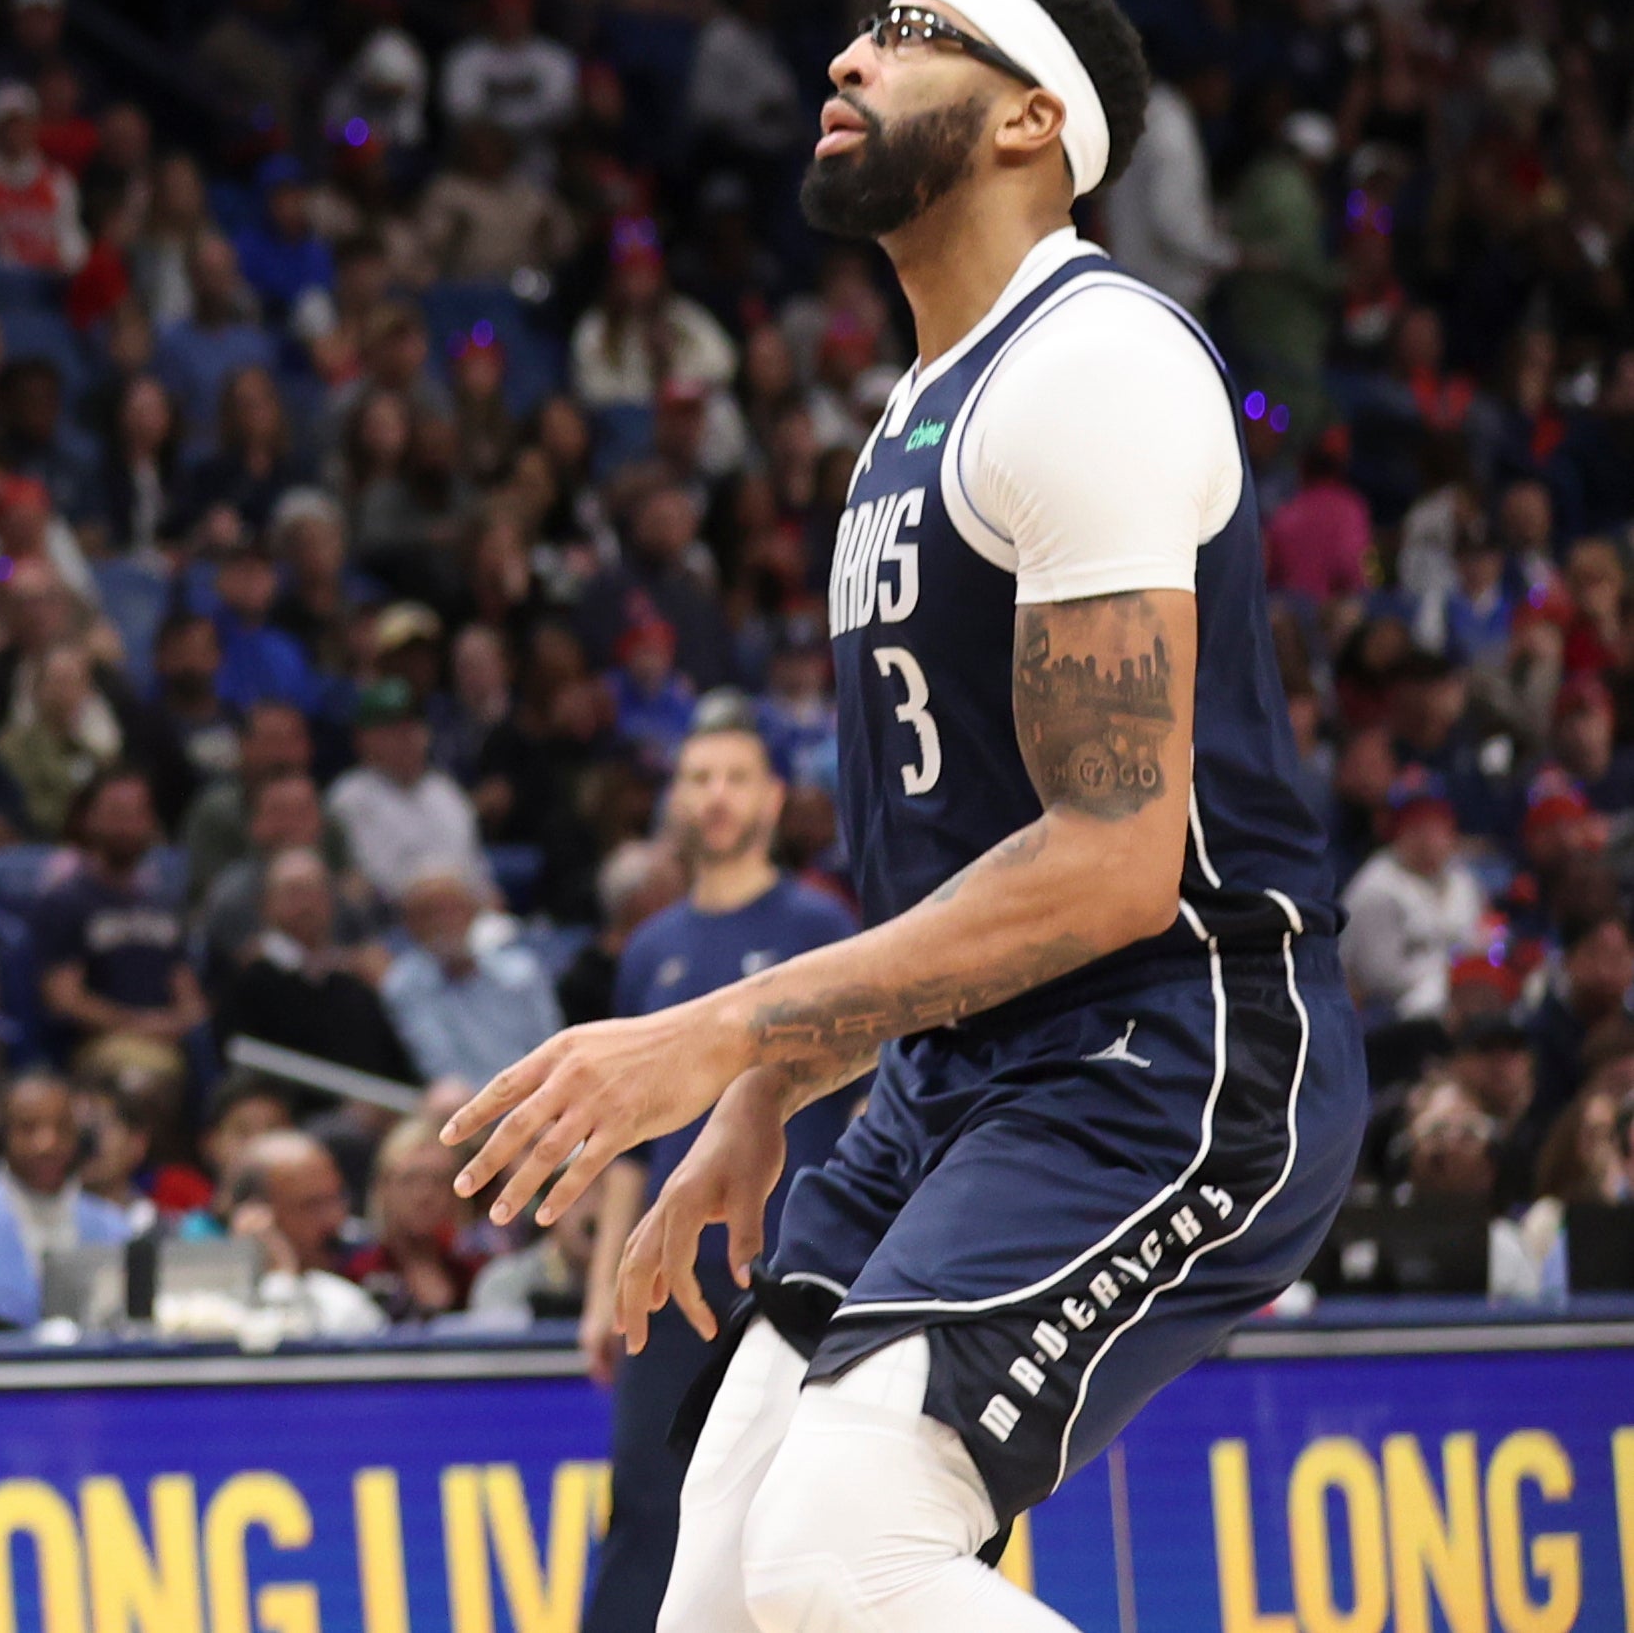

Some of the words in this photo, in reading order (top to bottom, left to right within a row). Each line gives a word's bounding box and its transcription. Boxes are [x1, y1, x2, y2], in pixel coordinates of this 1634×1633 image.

[903, 418, 947, 453] chime
[873, 645, 943, 797] 3
[978, 1184, 1233, 1443] MAVERICKS
[353, 1459, 614, 1633] LIV
[1208, 1427, 1583, 1633] LONG
